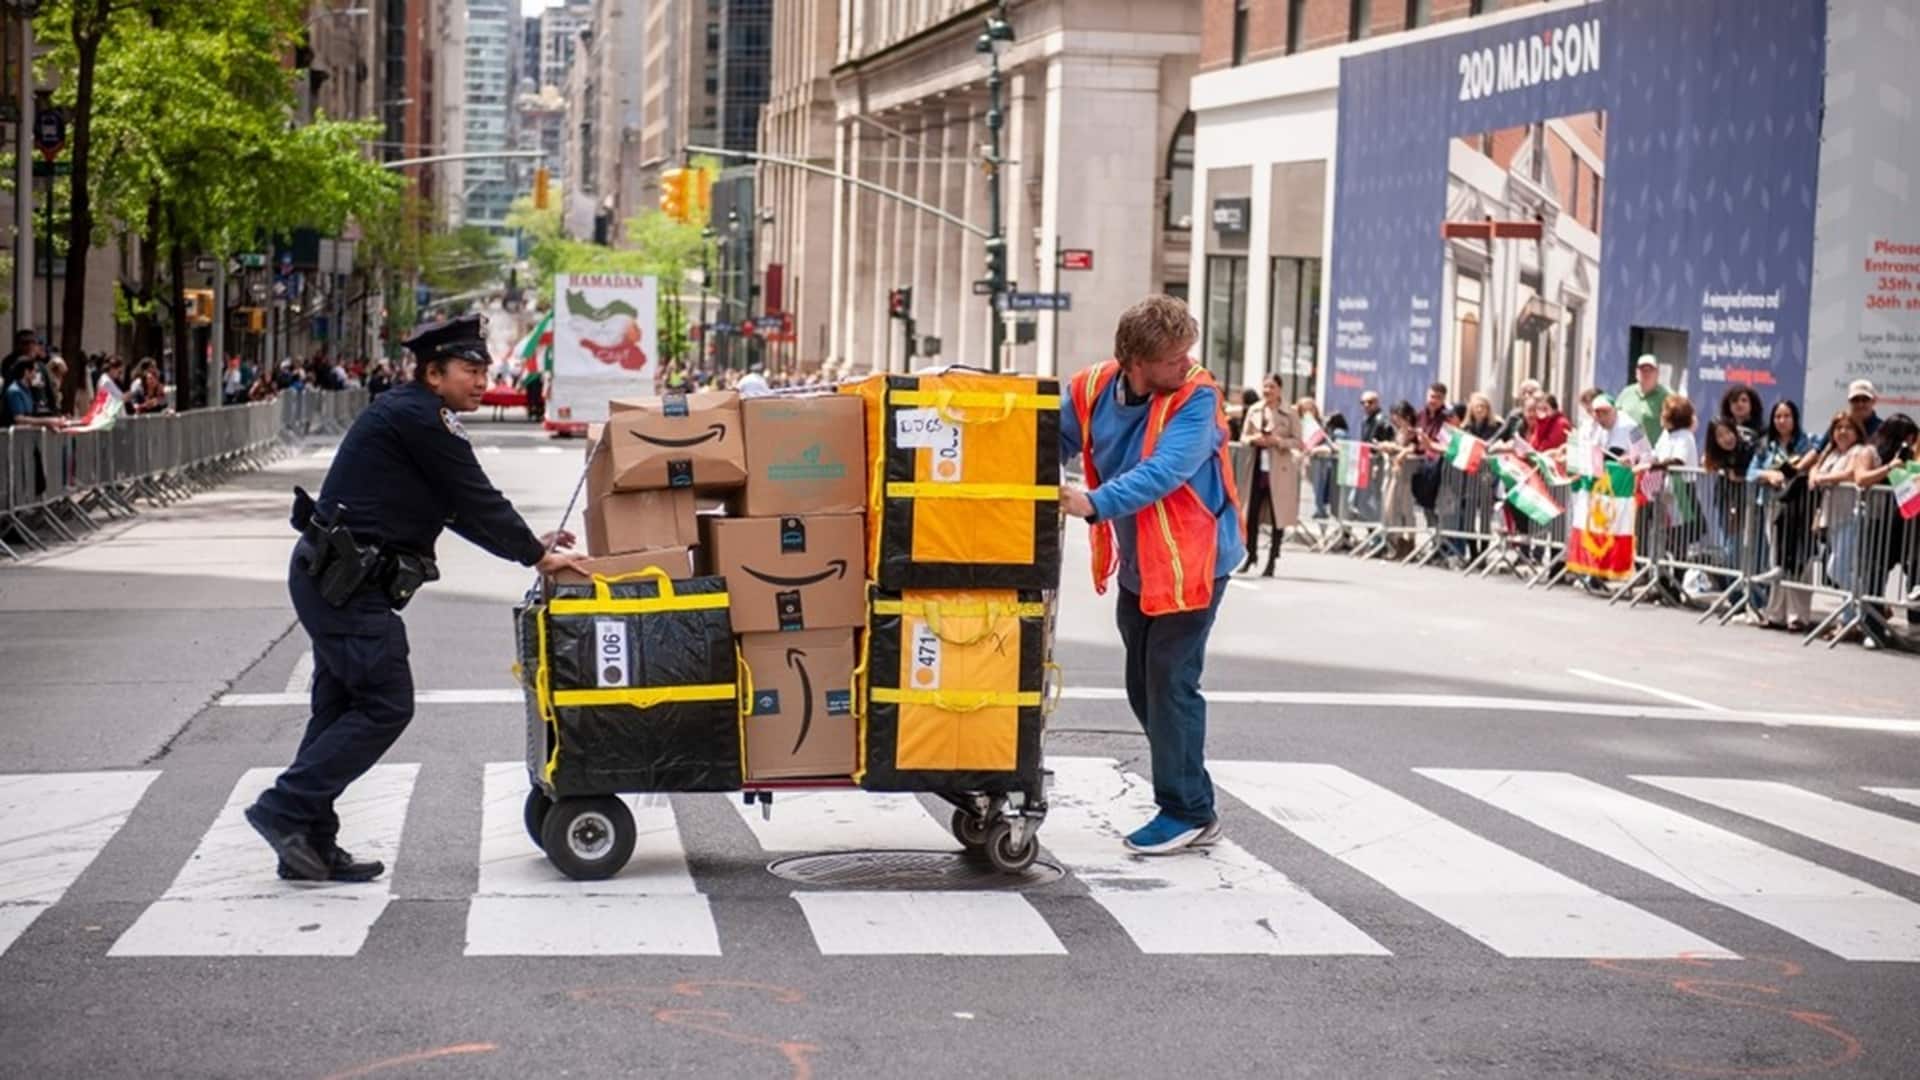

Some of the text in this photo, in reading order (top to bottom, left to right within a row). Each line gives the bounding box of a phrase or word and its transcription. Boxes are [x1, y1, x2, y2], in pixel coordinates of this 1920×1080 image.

[1459, 47, 1495, 101] 200
[1878, 277, 1912, 291] 35th
[1865, 294, 1901, 309] 36th
[603, 633, 621, 665] 106
[918, 637, 936, 667] 471
